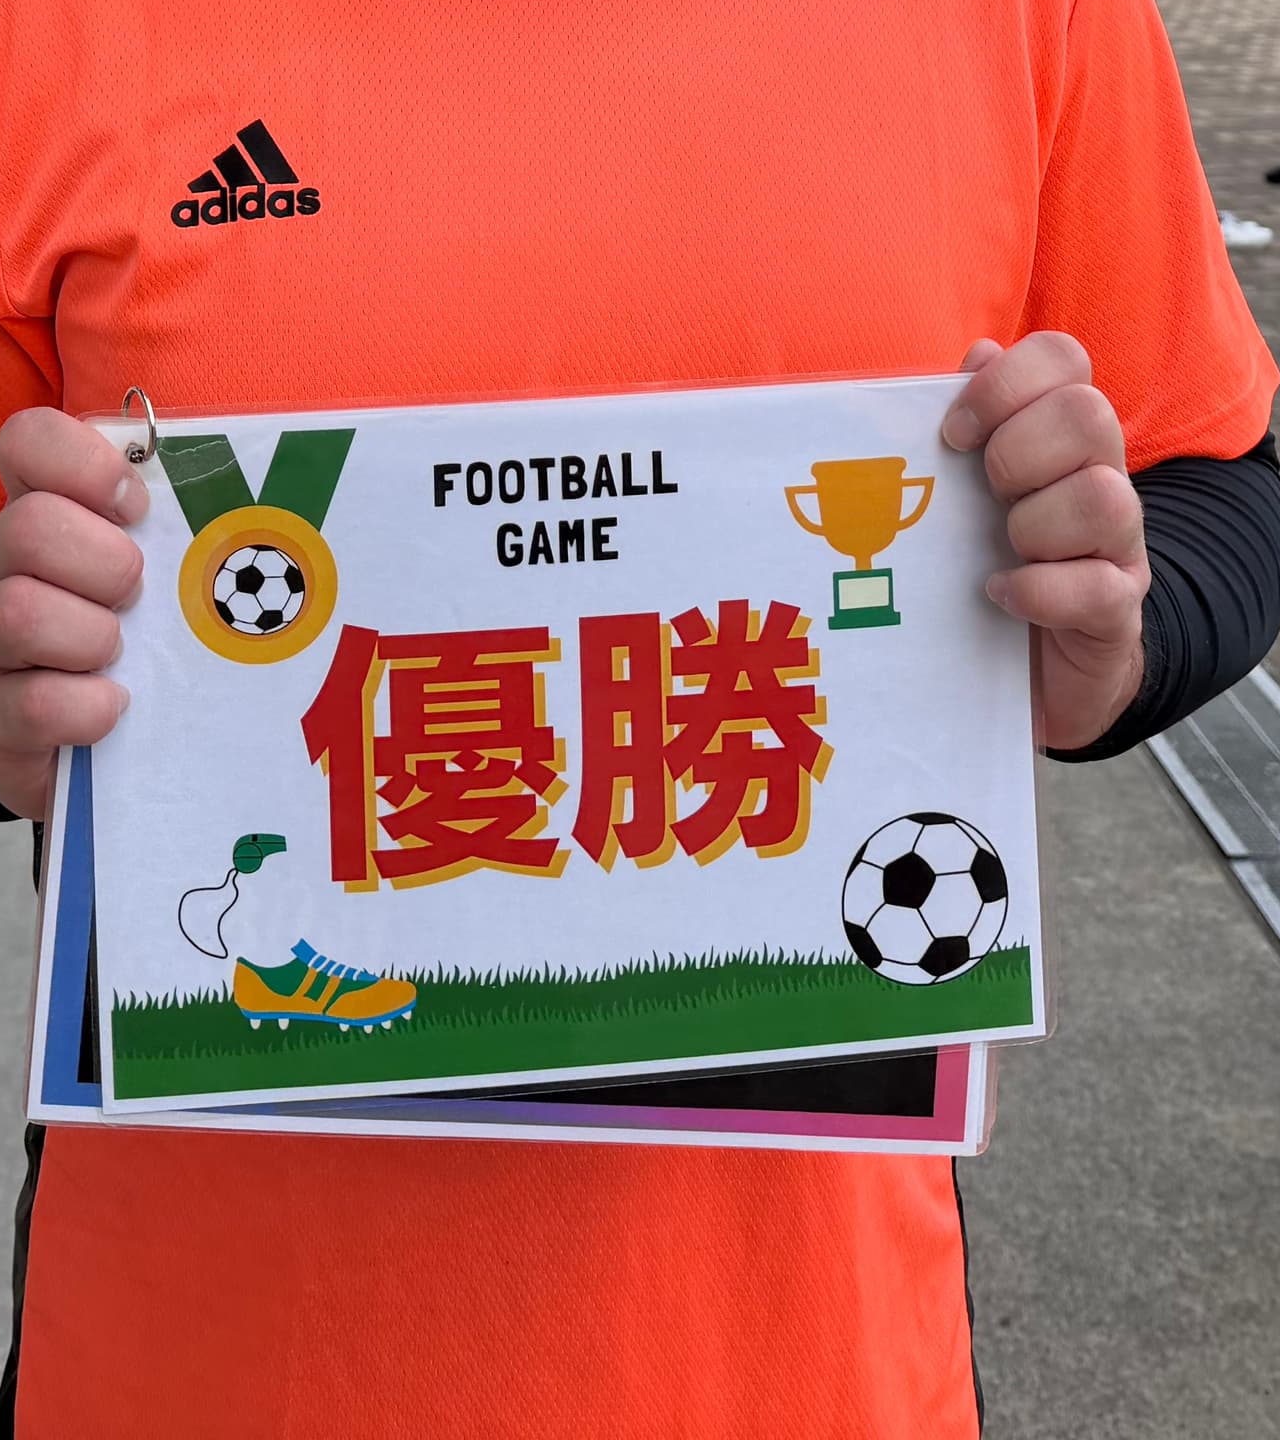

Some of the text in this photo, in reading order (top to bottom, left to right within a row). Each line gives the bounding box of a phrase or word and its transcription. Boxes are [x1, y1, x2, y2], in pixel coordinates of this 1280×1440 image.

[171, 183, 322, 228] adidas
[433, 450, 678, 507] FOOTBALL
[496, 517, 619, 567] GAME
[300, 599, 834, 892] 優勝
